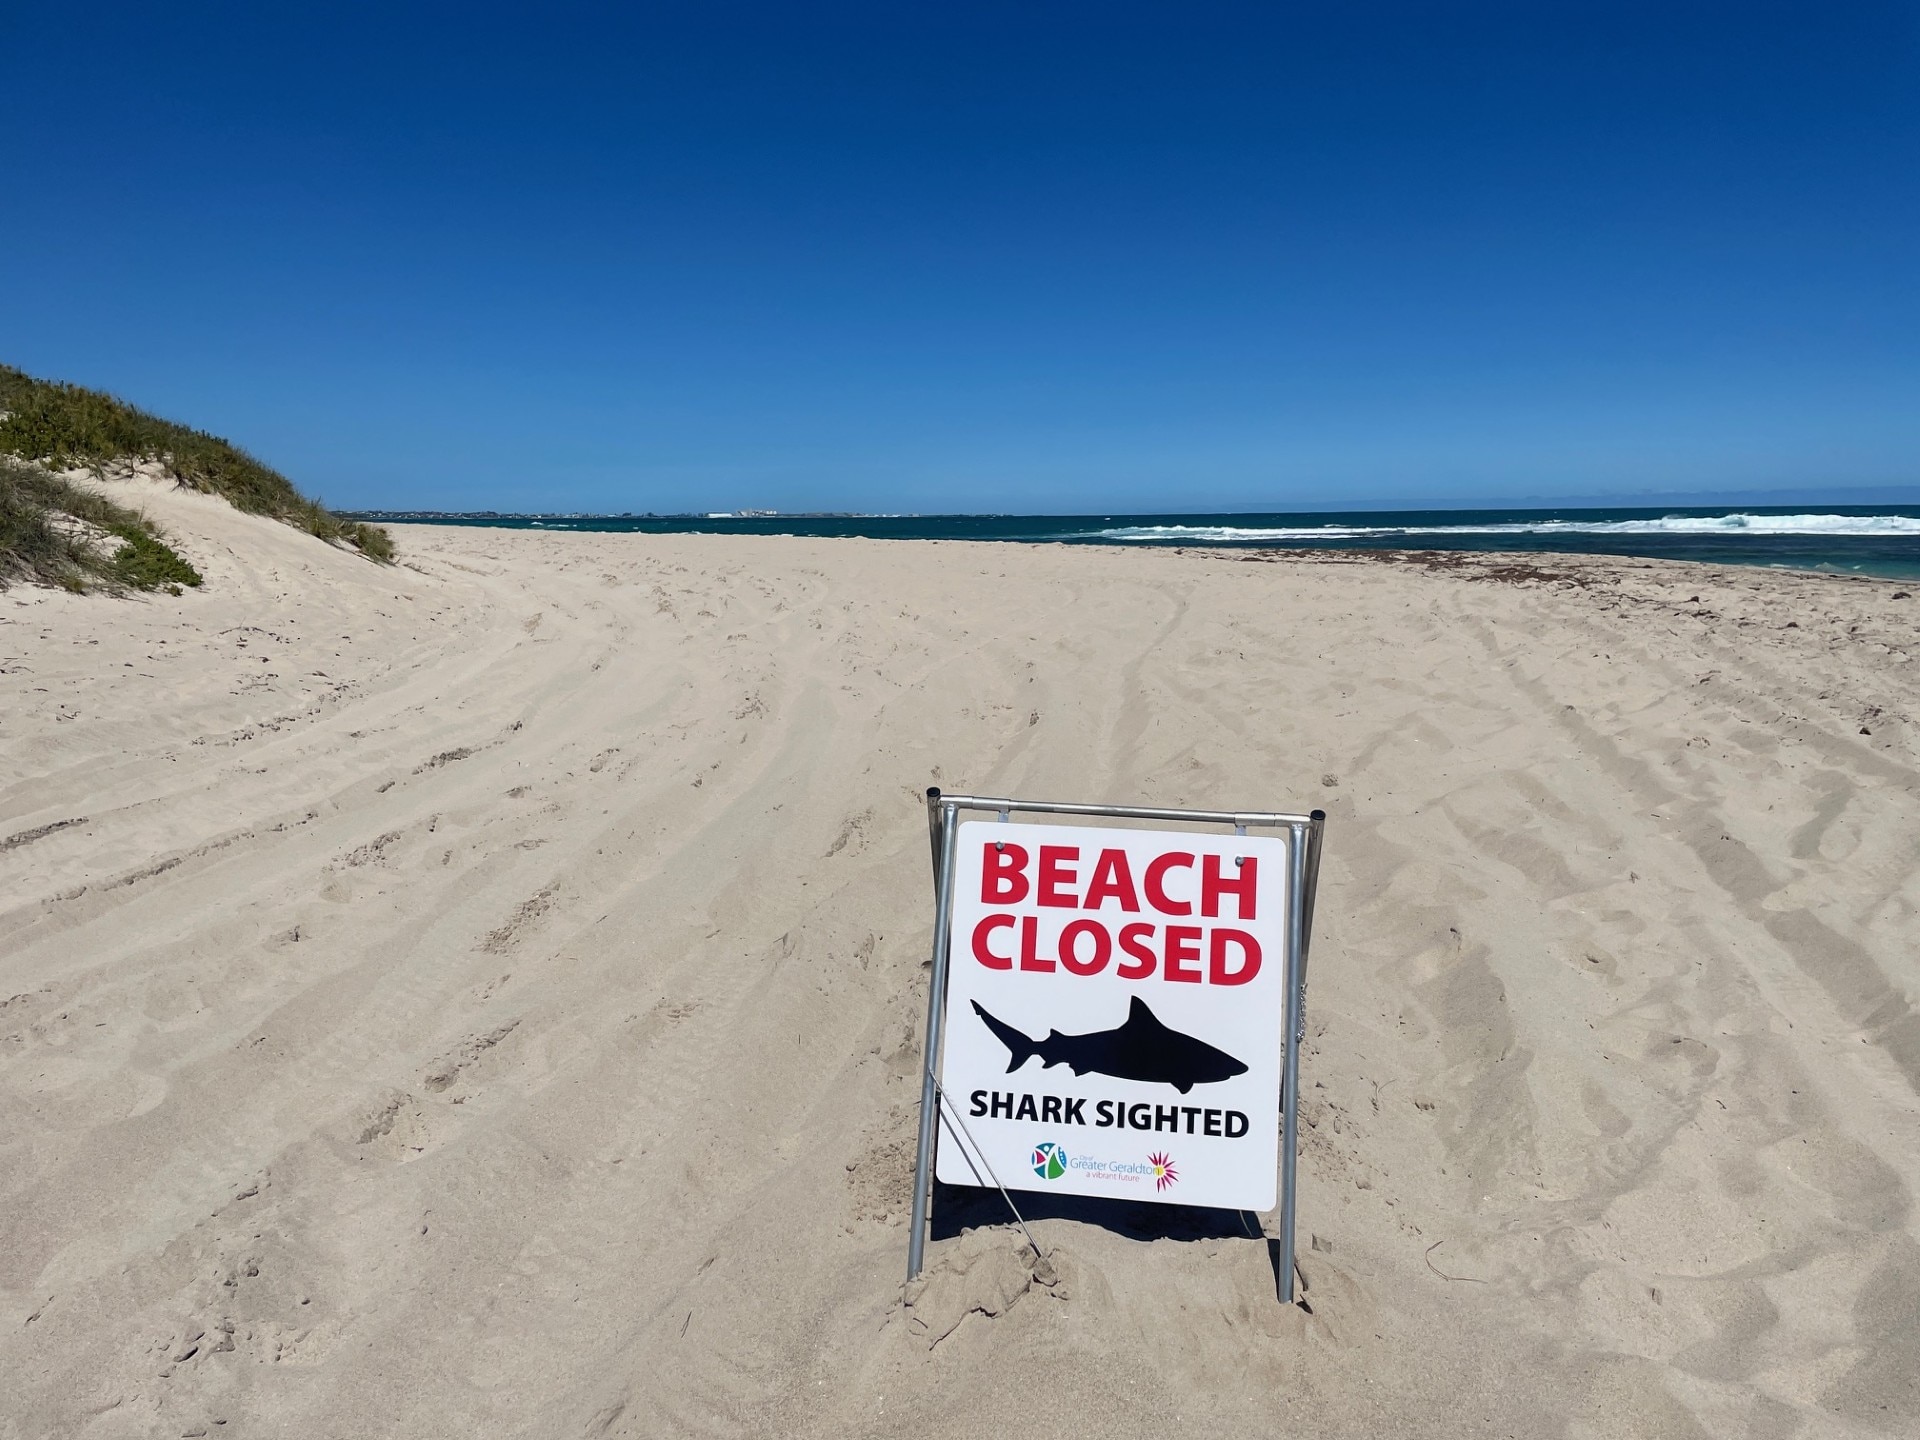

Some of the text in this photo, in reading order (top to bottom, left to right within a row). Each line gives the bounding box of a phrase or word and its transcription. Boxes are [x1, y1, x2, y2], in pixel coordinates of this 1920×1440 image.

[981, 842, 1257, 920] BEACH
[971, 914, 1262, 986] CLOSED
[969, 1090, 1249, 1138] SHARK SIGHTED
[1070, 1157, 1160, 1176] Greater Geraldton
[1092, 1172, 1117, 1181] vibrant
[1118, 1173, 1140, 1182] future
